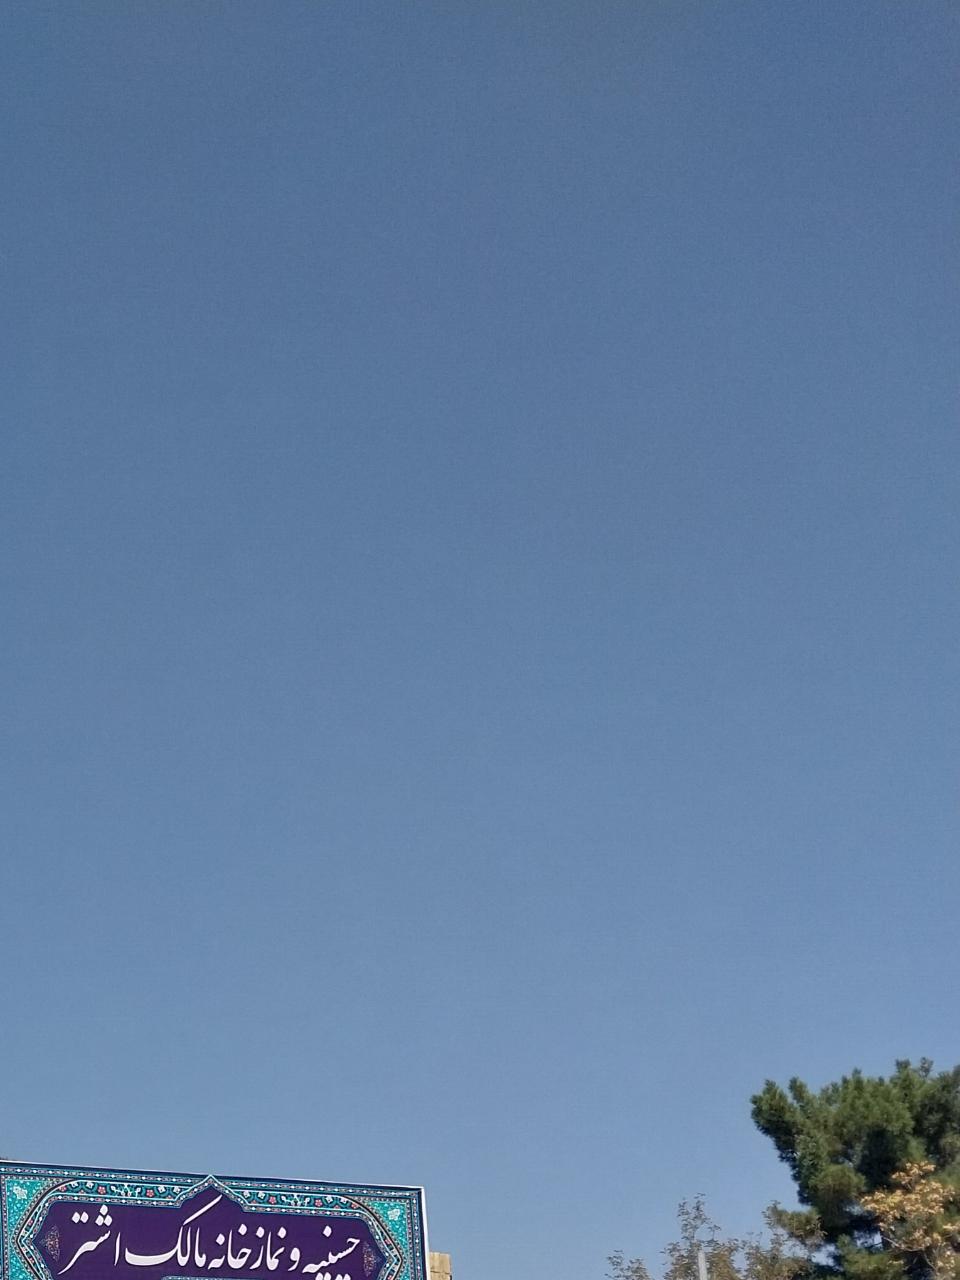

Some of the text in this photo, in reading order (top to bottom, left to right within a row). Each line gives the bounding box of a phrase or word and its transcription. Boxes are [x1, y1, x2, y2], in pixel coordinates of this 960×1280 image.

[57, 1204, 121, 1275] اشتر
[124, 1194, 223, 1268] مالک
[287, 1247, 301, 1272] و
